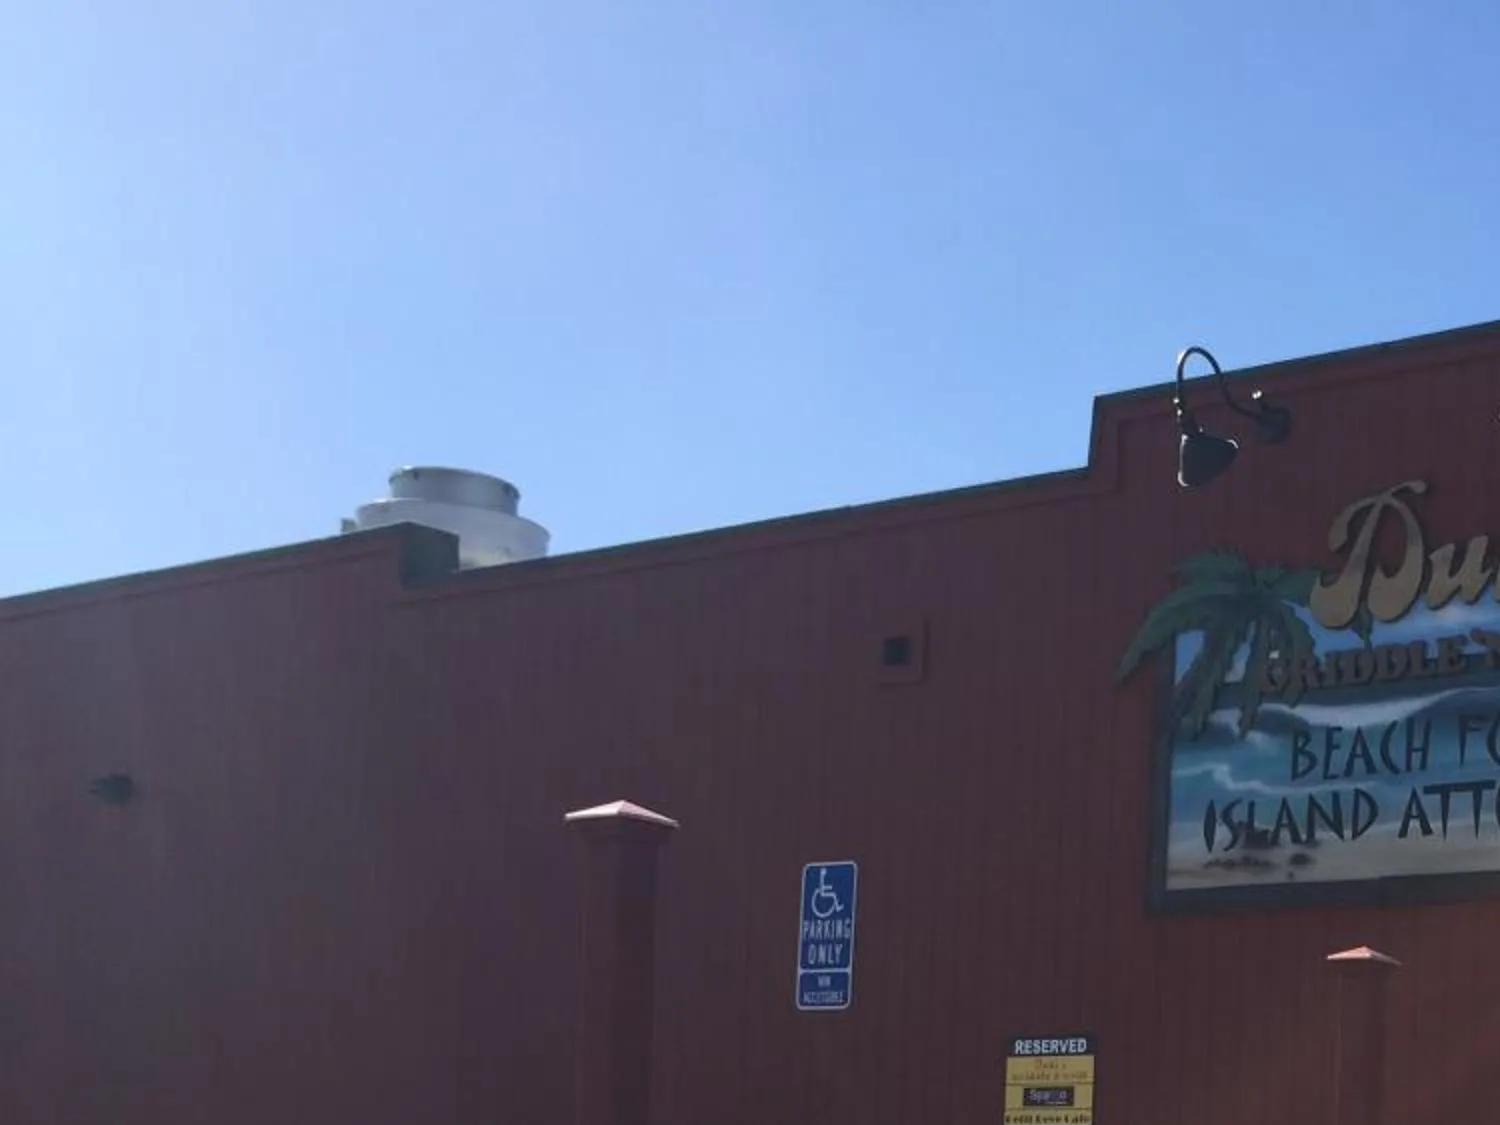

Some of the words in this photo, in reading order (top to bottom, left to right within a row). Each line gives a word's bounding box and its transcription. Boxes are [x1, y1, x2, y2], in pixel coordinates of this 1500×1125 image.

[1258, 634, 1468, 694] GRIDDLE
[1291, 720, 1432, 780] BEACH
[1203, 787, 1379, 852] ISLAND
[803, 918, 851, 940] PARKING
[808, 943, 843, 965] ONLY
[1014, 1038, 1087, 1055] RESERVED
